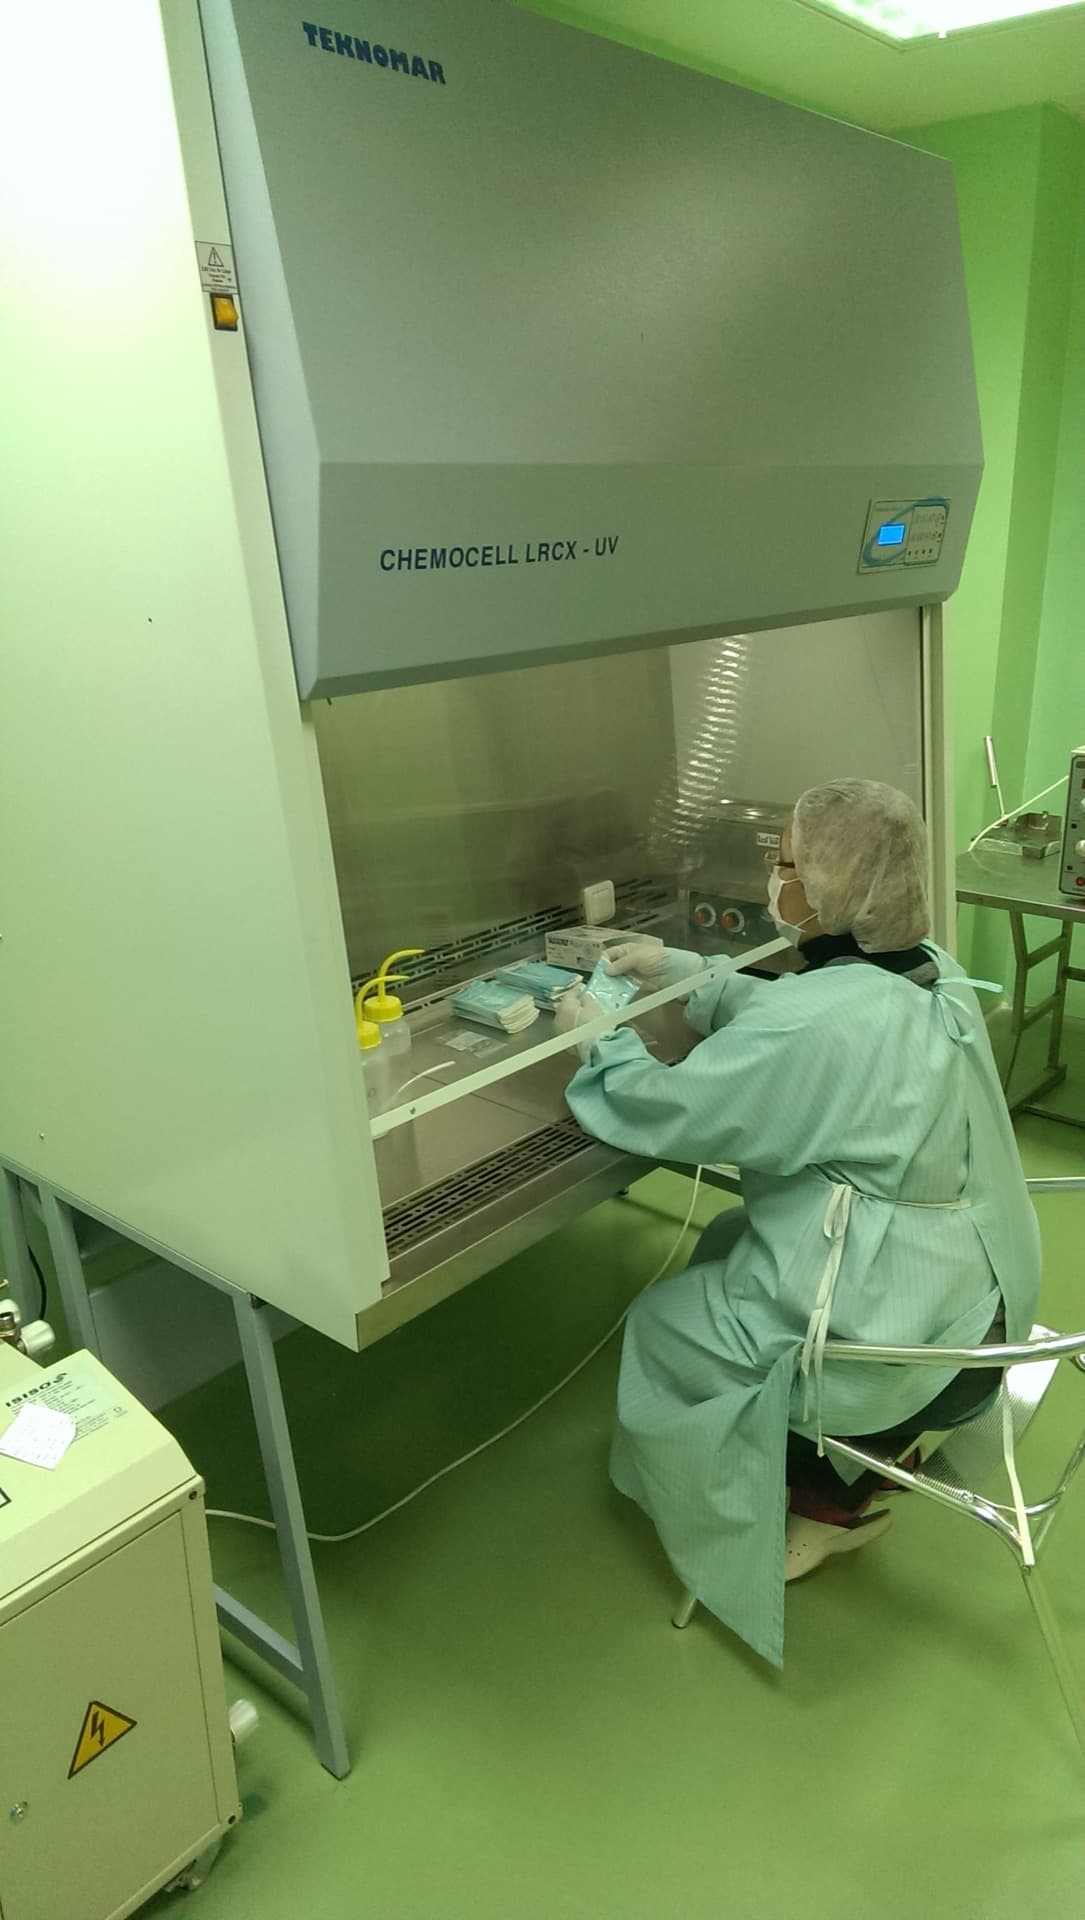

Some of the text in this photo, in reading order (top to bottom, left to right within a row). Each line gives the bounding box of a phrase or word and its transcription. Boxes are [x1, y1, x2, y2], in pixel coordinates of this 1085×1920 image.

[302, 21, 446, 84] TEKNOMAR
[380, 544, 518, 571] CHEMOCELL
[525, 541, 577, 563] LRCX
[595, 536, 619, 556] UV
